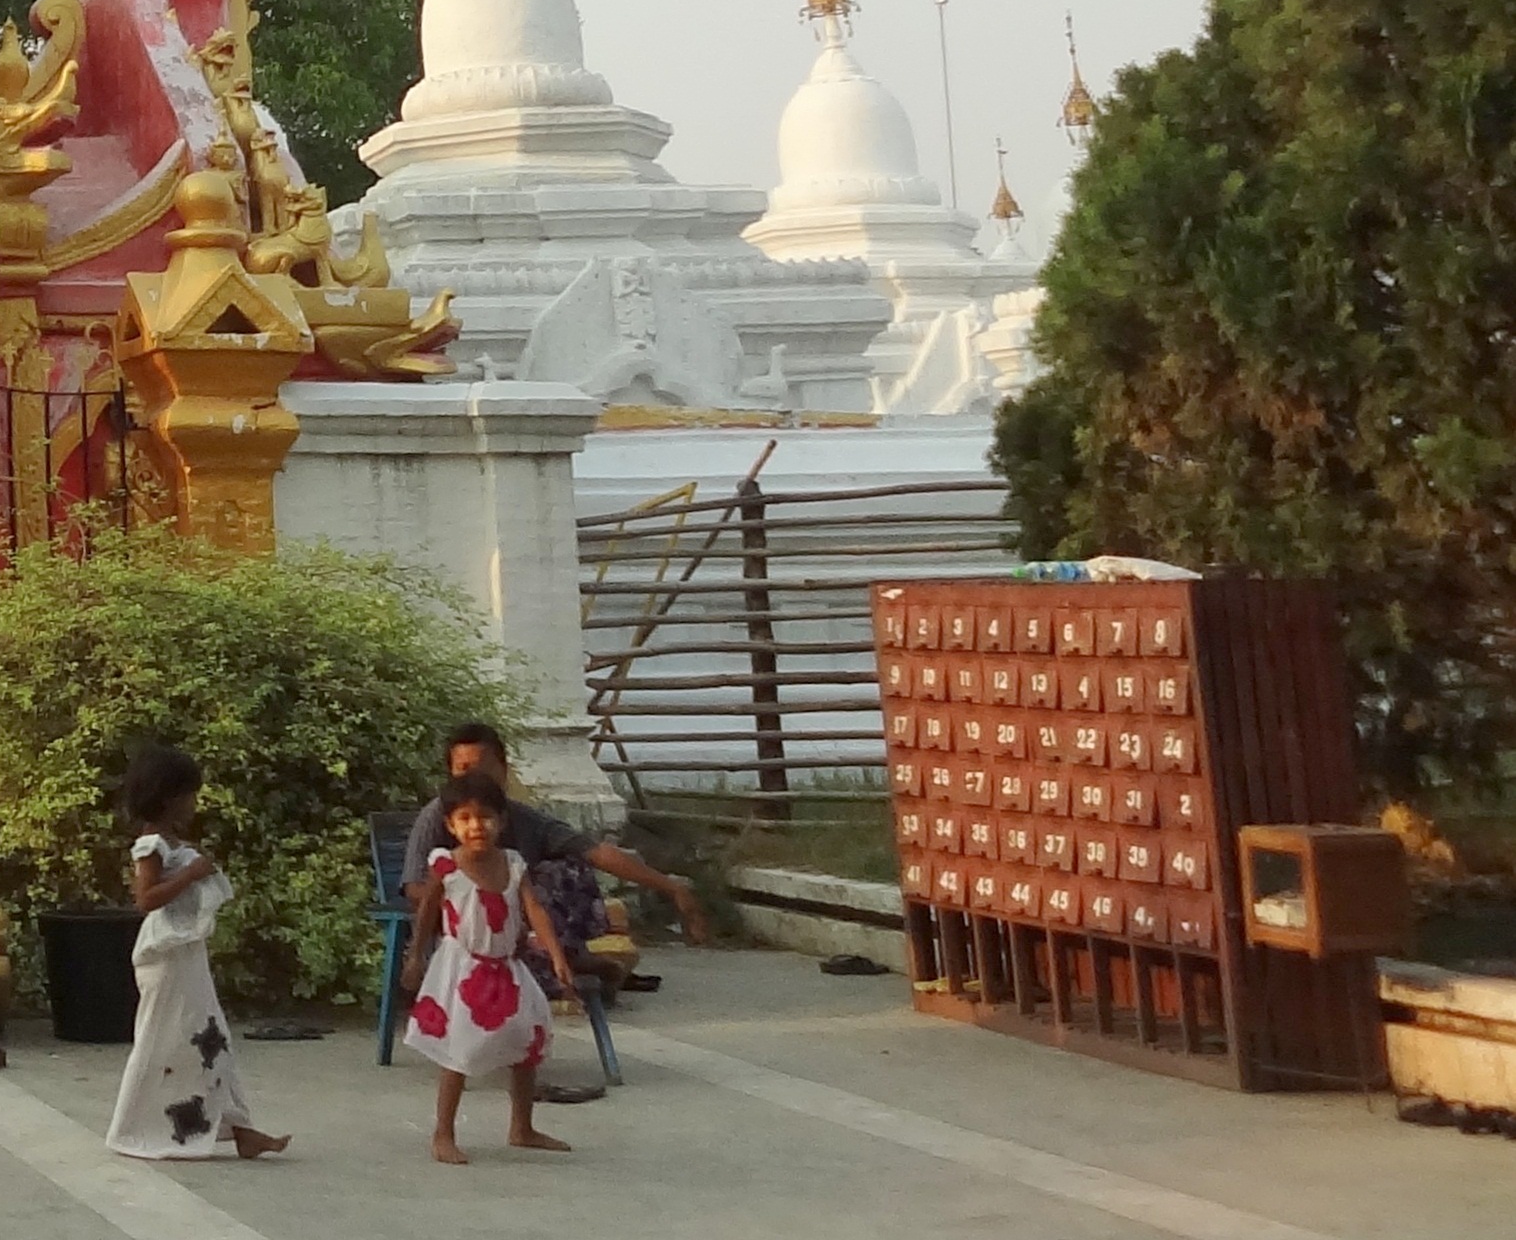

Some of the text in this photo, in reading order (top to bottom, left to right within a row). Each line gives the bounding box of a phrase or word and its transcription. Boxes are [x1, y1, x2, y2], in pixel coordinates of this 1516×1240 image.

[918, 618, 928, 635] 2
[952, 618, 963, 635] 3
[988, 619, 999, 636] 4
[1027, 619, 1039, 638] 5
[1063, 623, 1074, 642] 6
[1111, 621, 1123, 642] 7
[1154, 620, 1166, 645] 8
[890, 665, 900, 684] 9
[923, 668, 936, 686] 10
[959, 670, 971, 687] 11
[994, 671, 1008, 689] 12
[1031, 674, 1048, 693] 13
[1116, 677, 1134, 697] 15
[1158, 678, 1176, 699] 16
[894, 716, 1182, 759] 17 18 19 20 21 22 23 24
[896, 764, 913, 783] 25
[932, 767, 951, 786] 26
[1001, 776, 1021, 795] 28
[1040, 780, 1058, 799] 29
[1082, 786, 1102, 805] 30
[1126, 790, 1142, 809] 31
[902, 815, 1195, 876] 33 34 35 36 37 38 39 40
[907, 865, 921, 882] 41
[939, 871, 958, 891] 42
[975, 877, 994, 896] 43
[1011, 882, 1030, 905] 44
[1049, 889, 1069, 909] 45
[1092, 897, 1112, 917] 46
